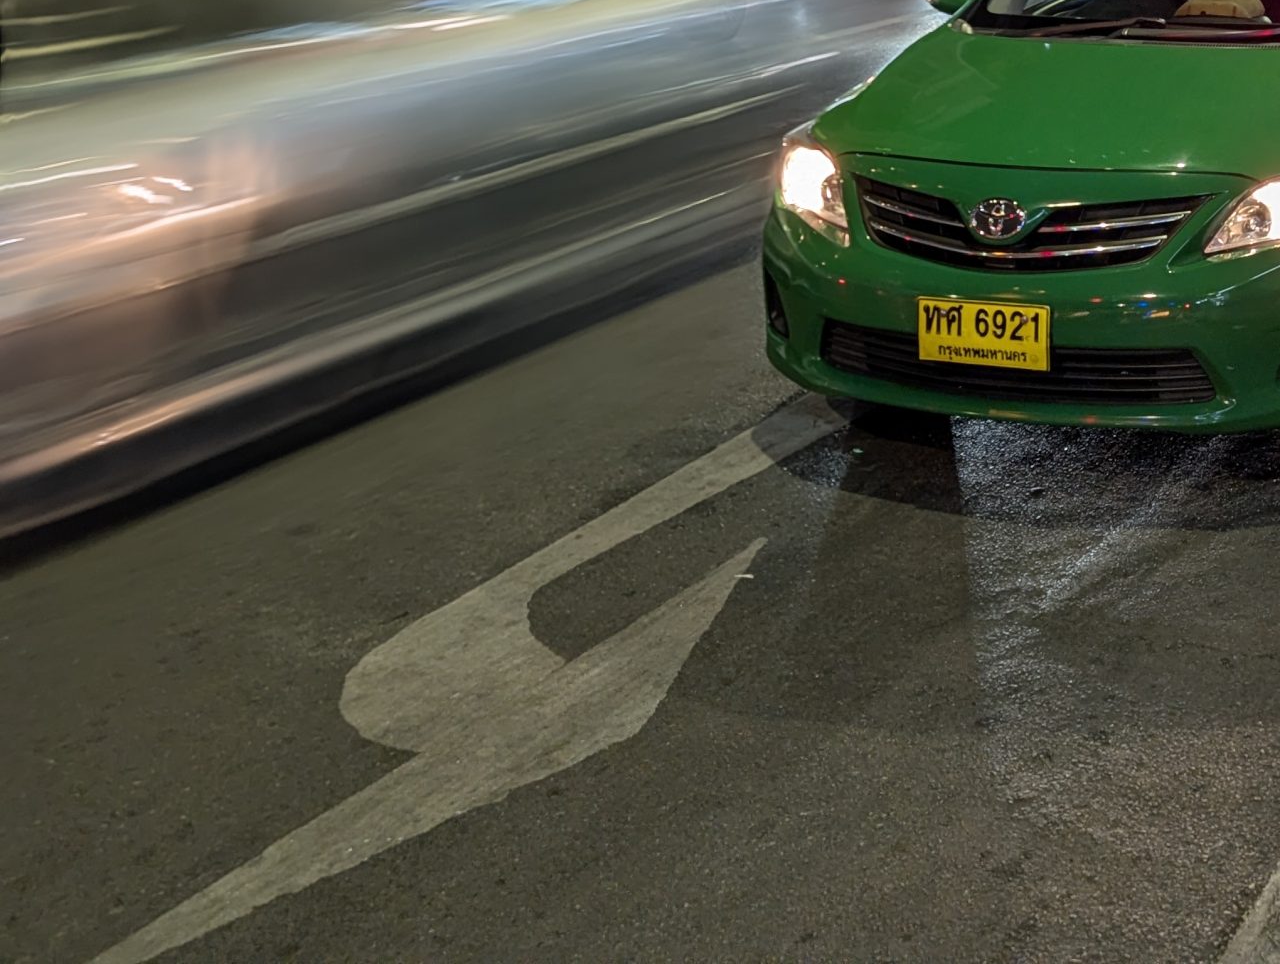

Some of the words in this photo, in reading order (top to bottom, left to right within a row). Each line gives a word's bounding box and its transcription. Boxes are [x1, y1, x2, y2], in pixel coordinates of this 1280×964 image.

[975, 308, 1040, 343] 6921
[938, 344, 1028, 363] กรุงเทพมหานคร
